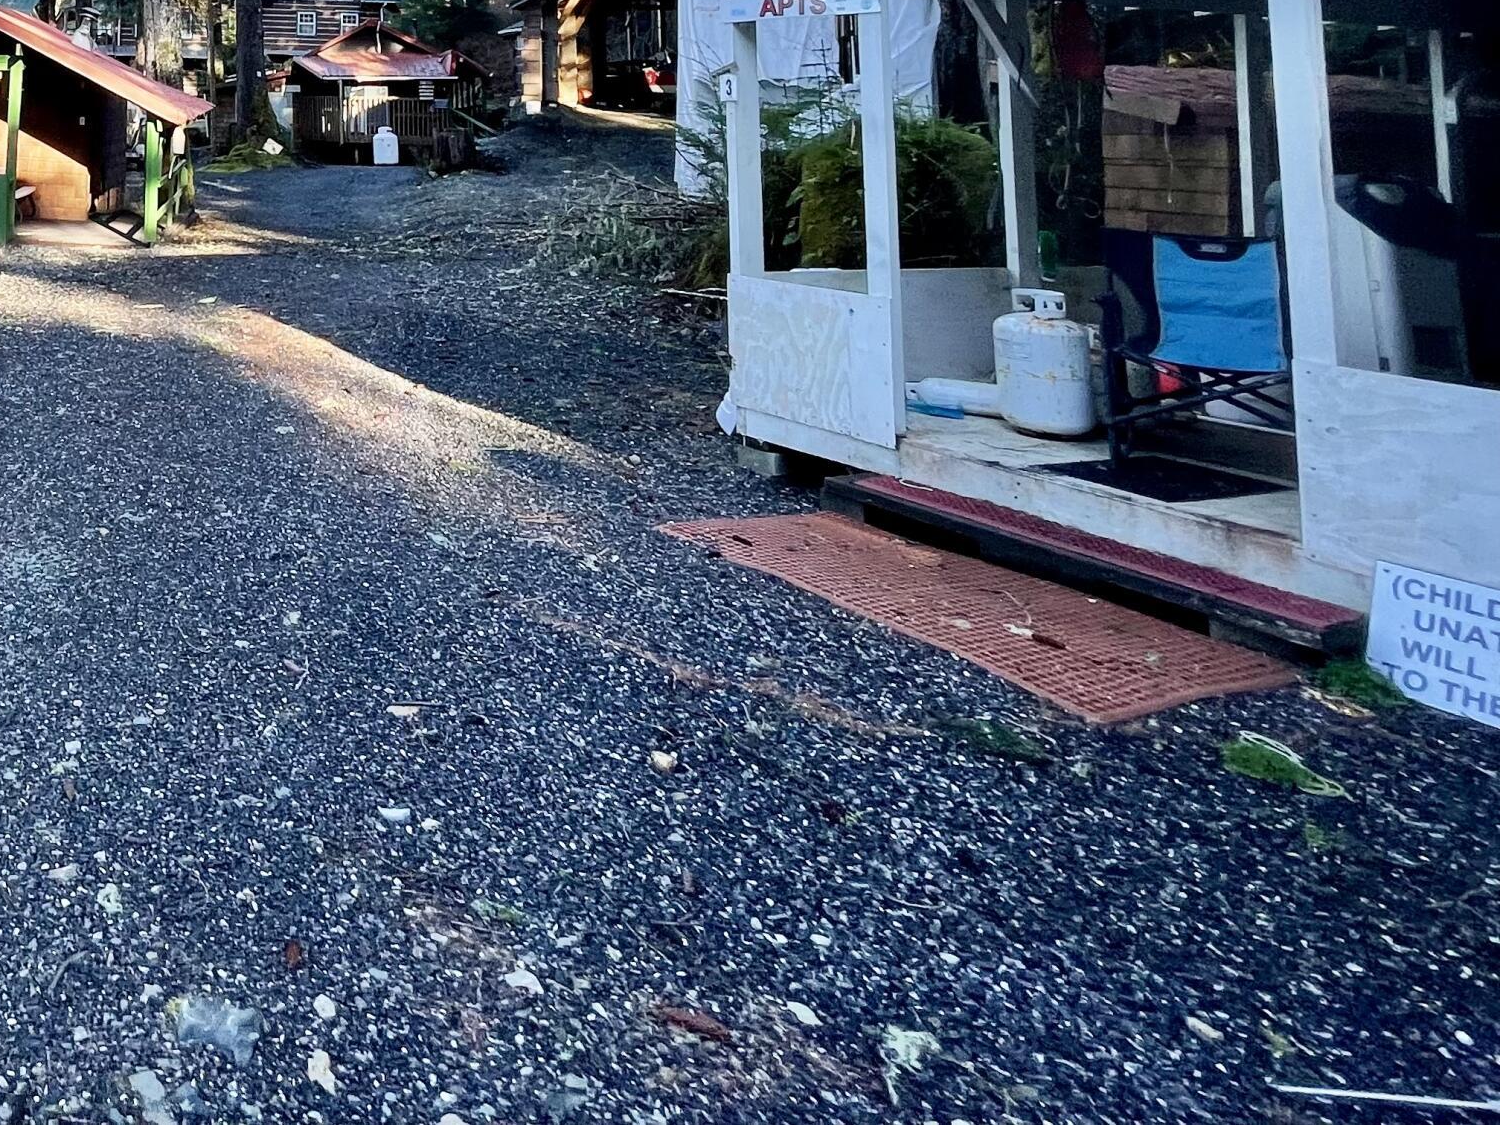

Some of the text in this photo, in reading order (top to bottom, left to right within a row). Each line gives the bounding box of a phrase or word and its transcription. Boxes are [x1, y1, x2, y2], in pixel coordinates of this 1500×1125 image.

[725, 79, 732, 96] 3
[1400, 636, 1486, 682] WILL
[1382, 661, 1500, 719] TO THE
